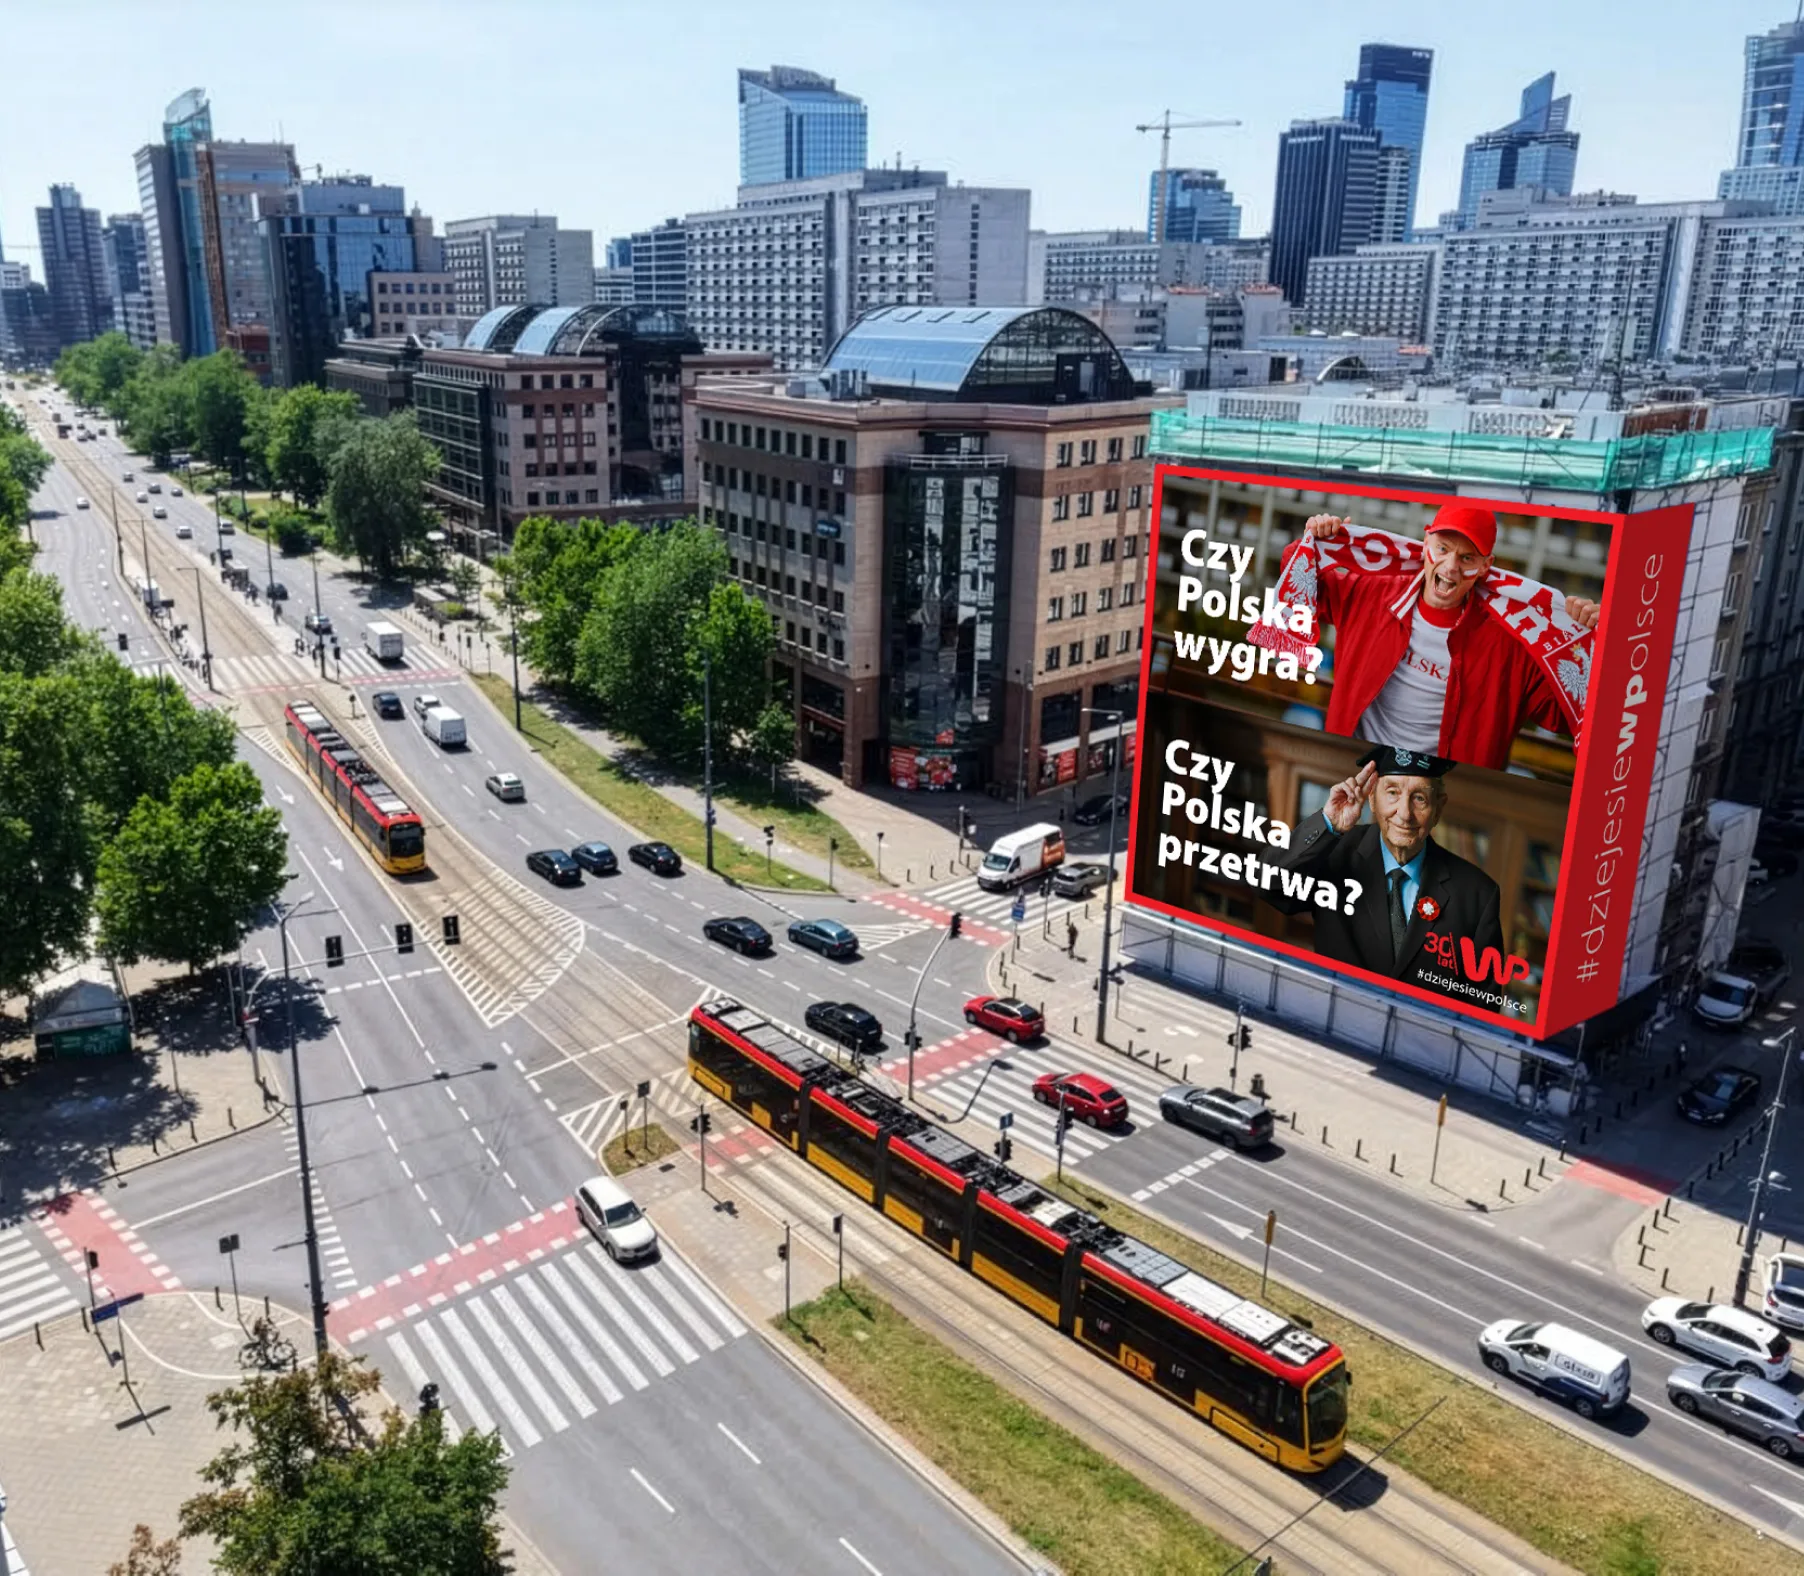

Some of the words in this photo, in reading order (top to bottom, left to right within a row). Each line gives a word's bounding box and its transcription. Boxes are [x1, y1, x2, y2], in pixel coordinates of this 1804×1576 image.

[1181, 529, 1255, 583] Czy
[1177, 575, 1313, 634] Polska
[1174, 630, 1324, 685] wygra?
[1401, 651, 1449, 682] LSK
[1165, 739, 1235, 794] Czy
[1576, 553, 1664, 983] #dziejesiewpolsce
[1162, 781, 1291, 849] Polska
[1158, 832, 1363, 916] przetrwa?
[1423, 931, 1452, 958] 30
[1437, 955, 1455, 970] lat
[1417, 968, 1528, 1013] #dziejesiewpolsce
